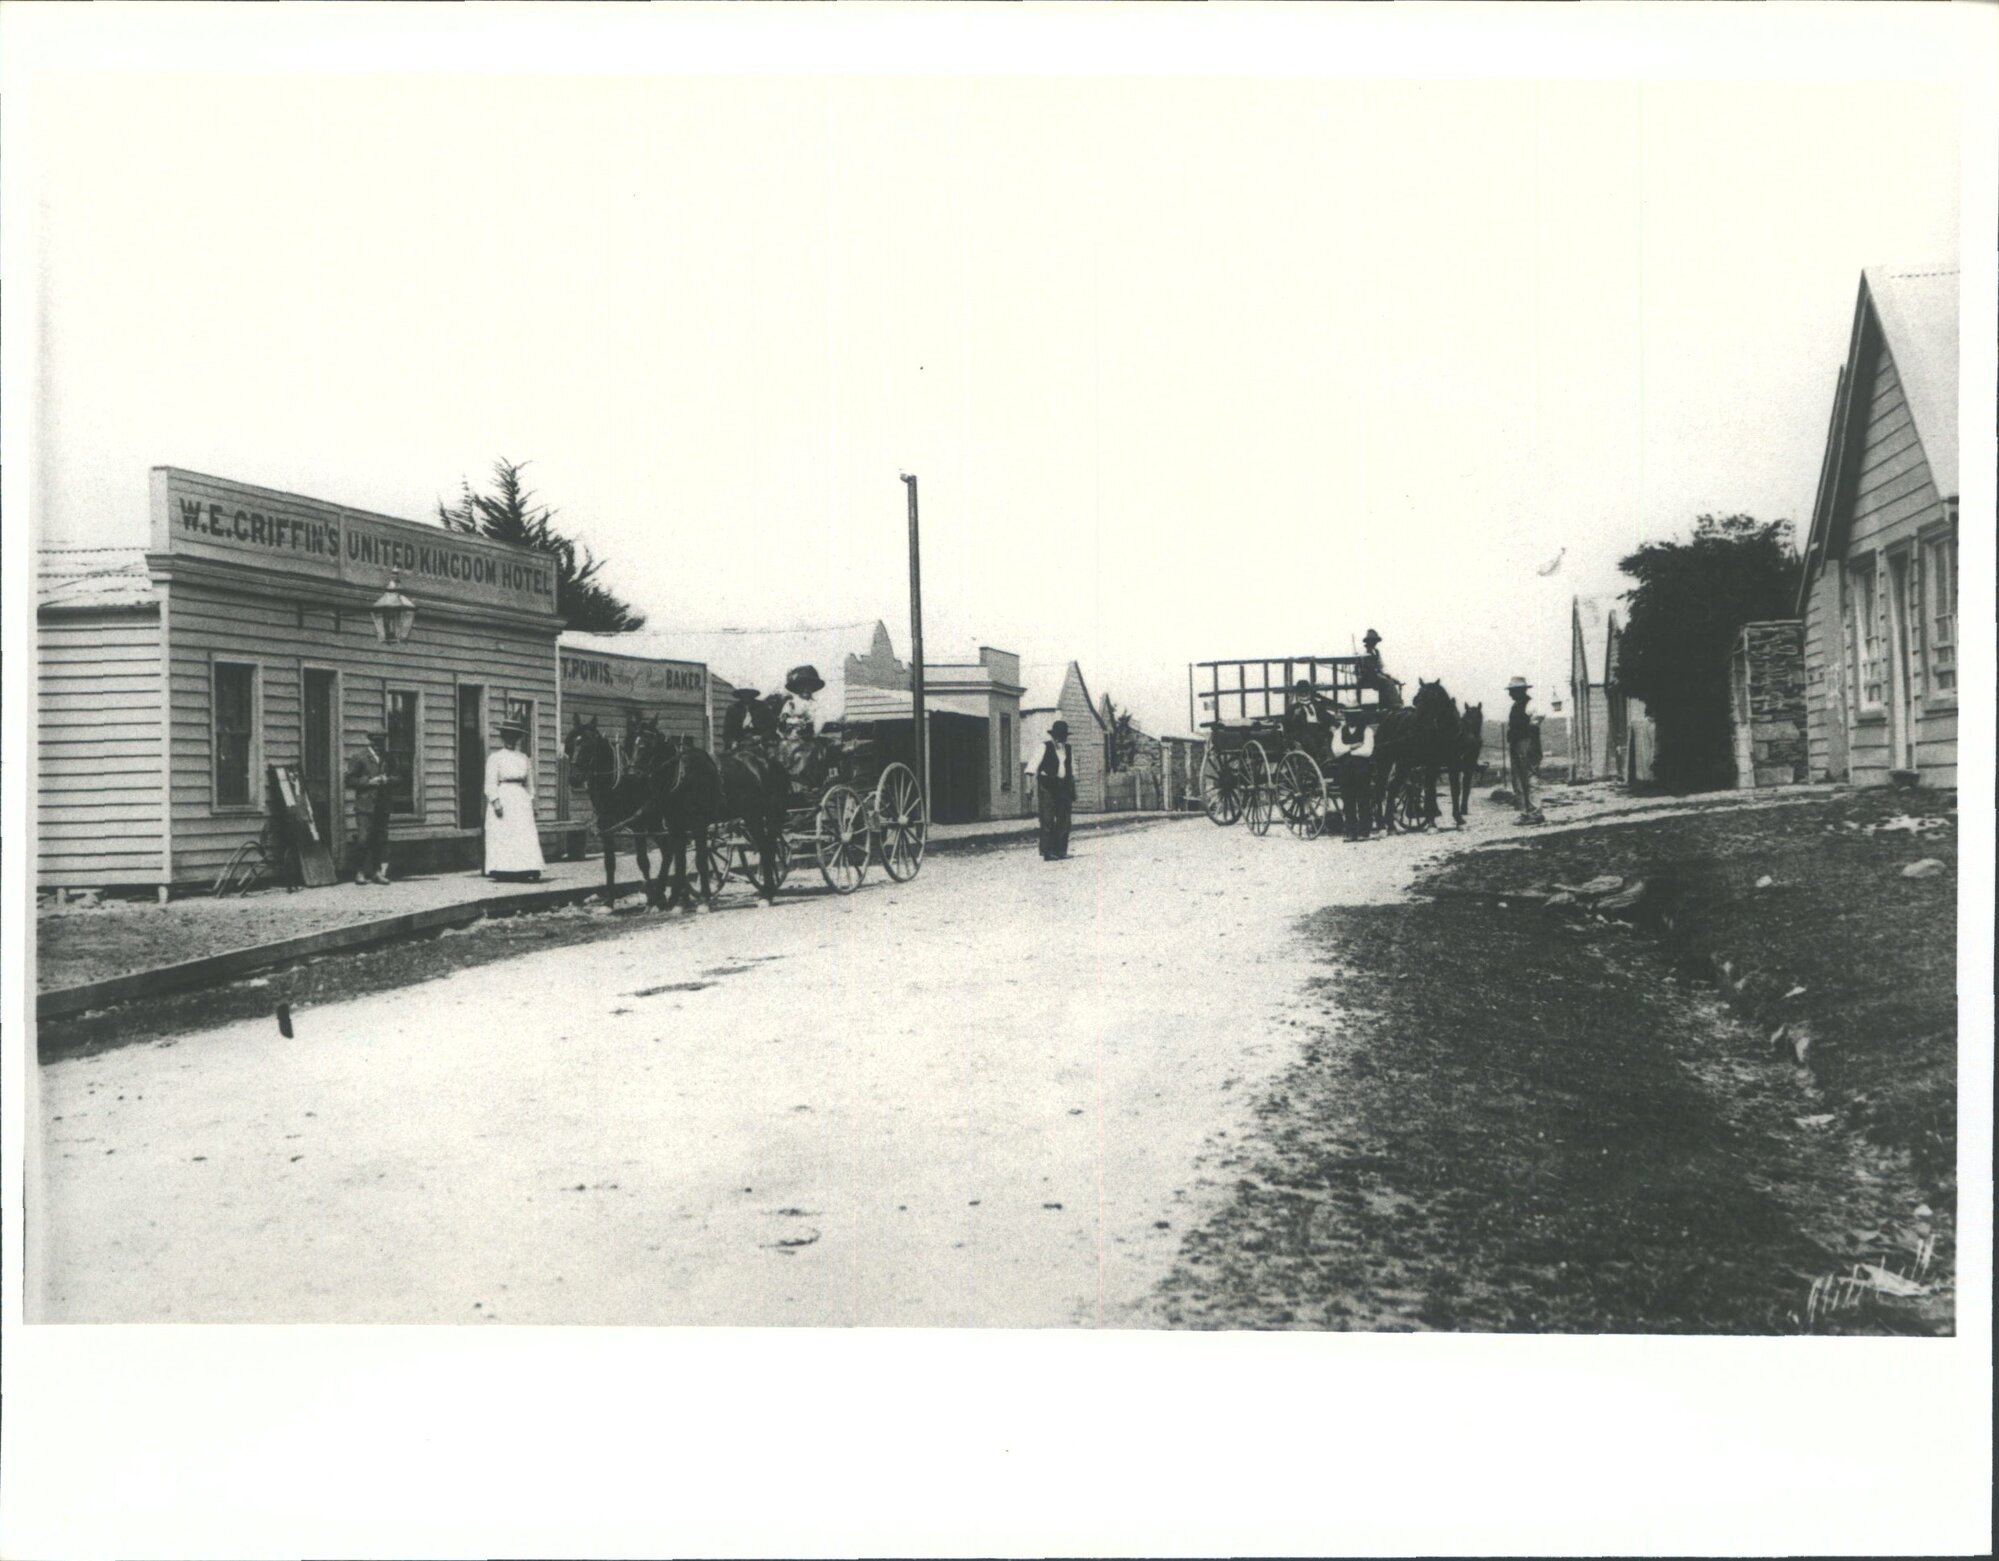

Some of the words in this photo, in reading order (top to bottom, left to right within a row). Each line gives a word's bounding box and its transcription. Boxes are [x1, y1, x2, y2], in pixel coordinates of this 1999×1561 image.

[348, 532, 414, 570] UNITED
[419, 547, 496, 585] KINGDOM
[502, 563, 553, 596] HOTEL
